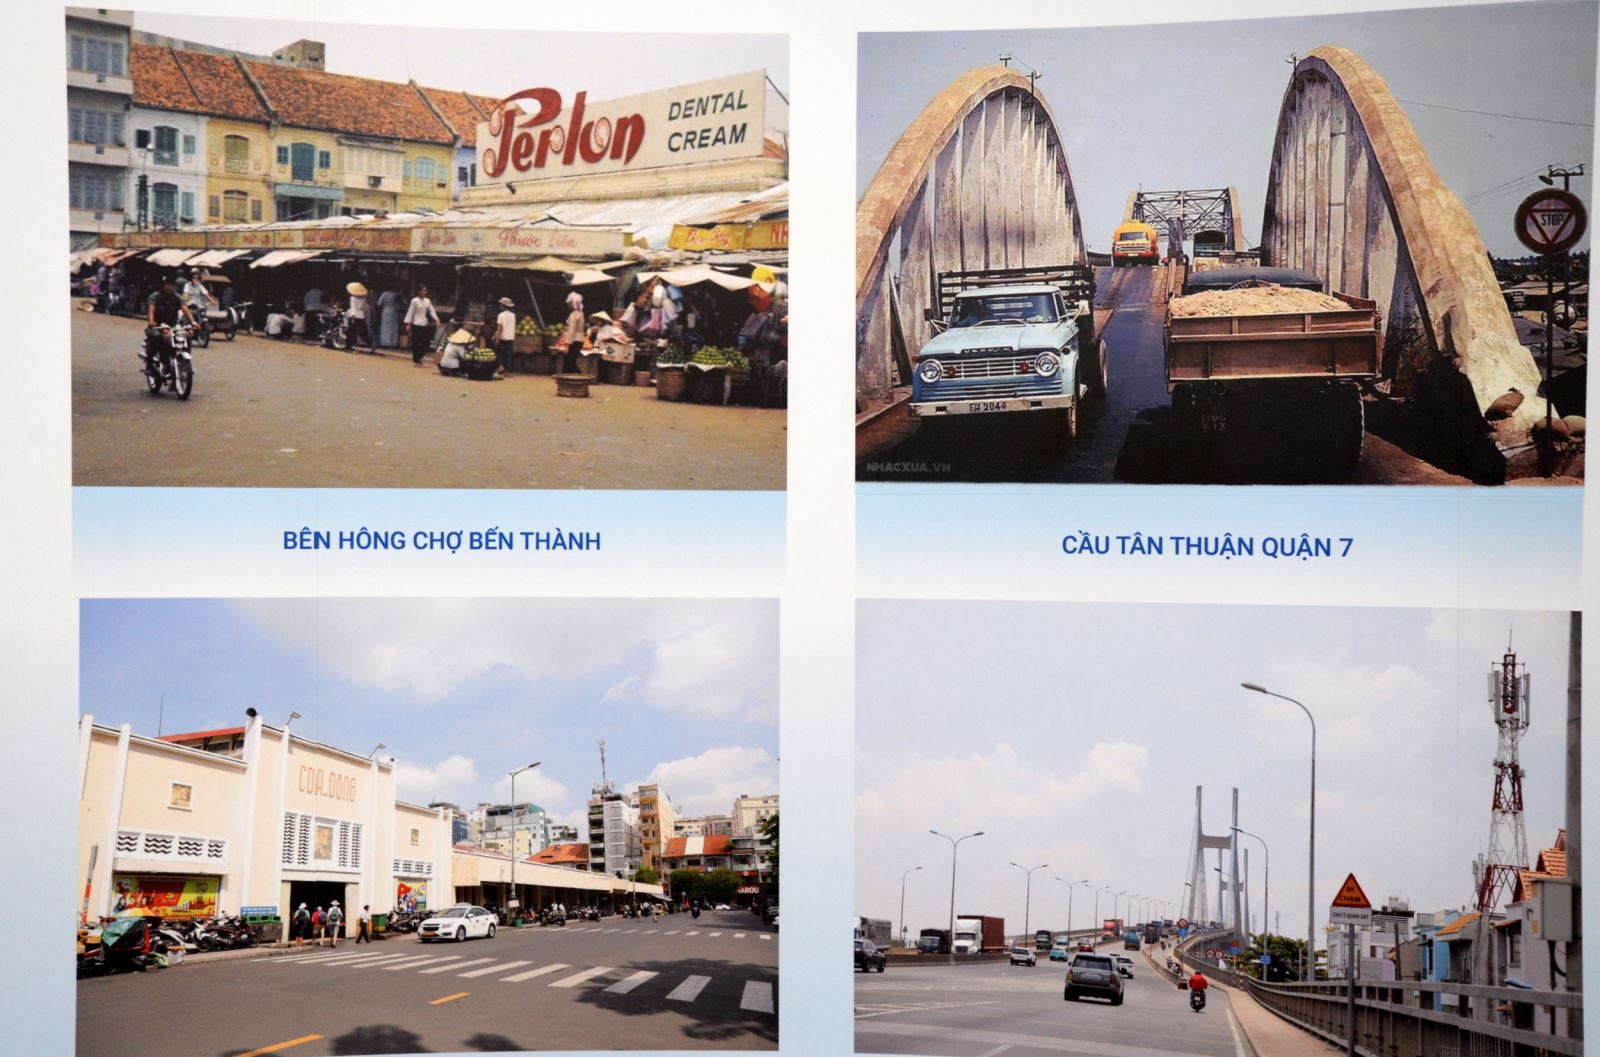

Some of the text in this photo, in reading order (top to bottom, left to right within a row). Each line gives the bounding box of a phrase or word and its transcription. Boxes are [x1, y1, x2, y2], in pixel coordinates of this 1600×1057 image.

[668, 89, 748, 121] DENTAL
[483, 87, 645, 177] Perlon
[668, 122, 747, 153] CREAM
[1541, 213, 1564, 226] STOP
[283, 526, 601, 554] BÊN HÔNG CHỢ BẾN THÀNH
[1062, 529, 1354, 561] CẦU TÂN THUẬN QUẬN 7
